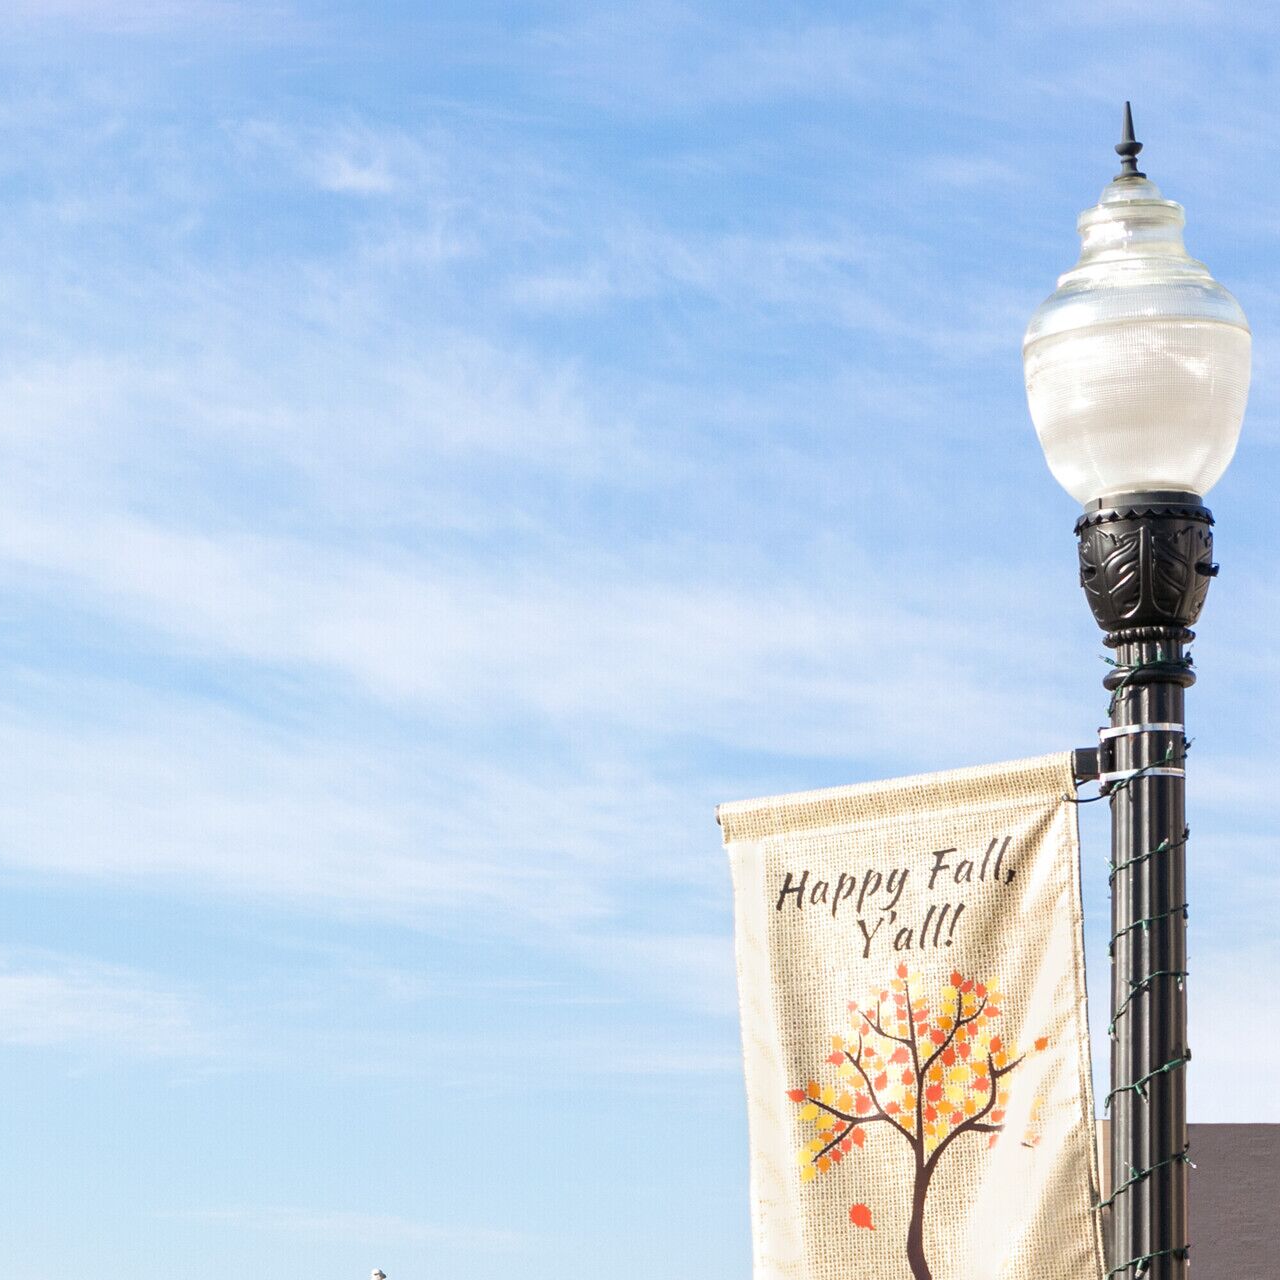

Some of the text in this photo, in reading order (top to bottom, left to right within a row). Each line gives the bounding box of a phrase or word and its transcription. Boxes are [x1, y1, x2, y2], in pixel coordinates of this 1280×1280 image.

[776, 835, 1017, 919] Happy Fall,
[857, 902, 966, 959] Y'all!
